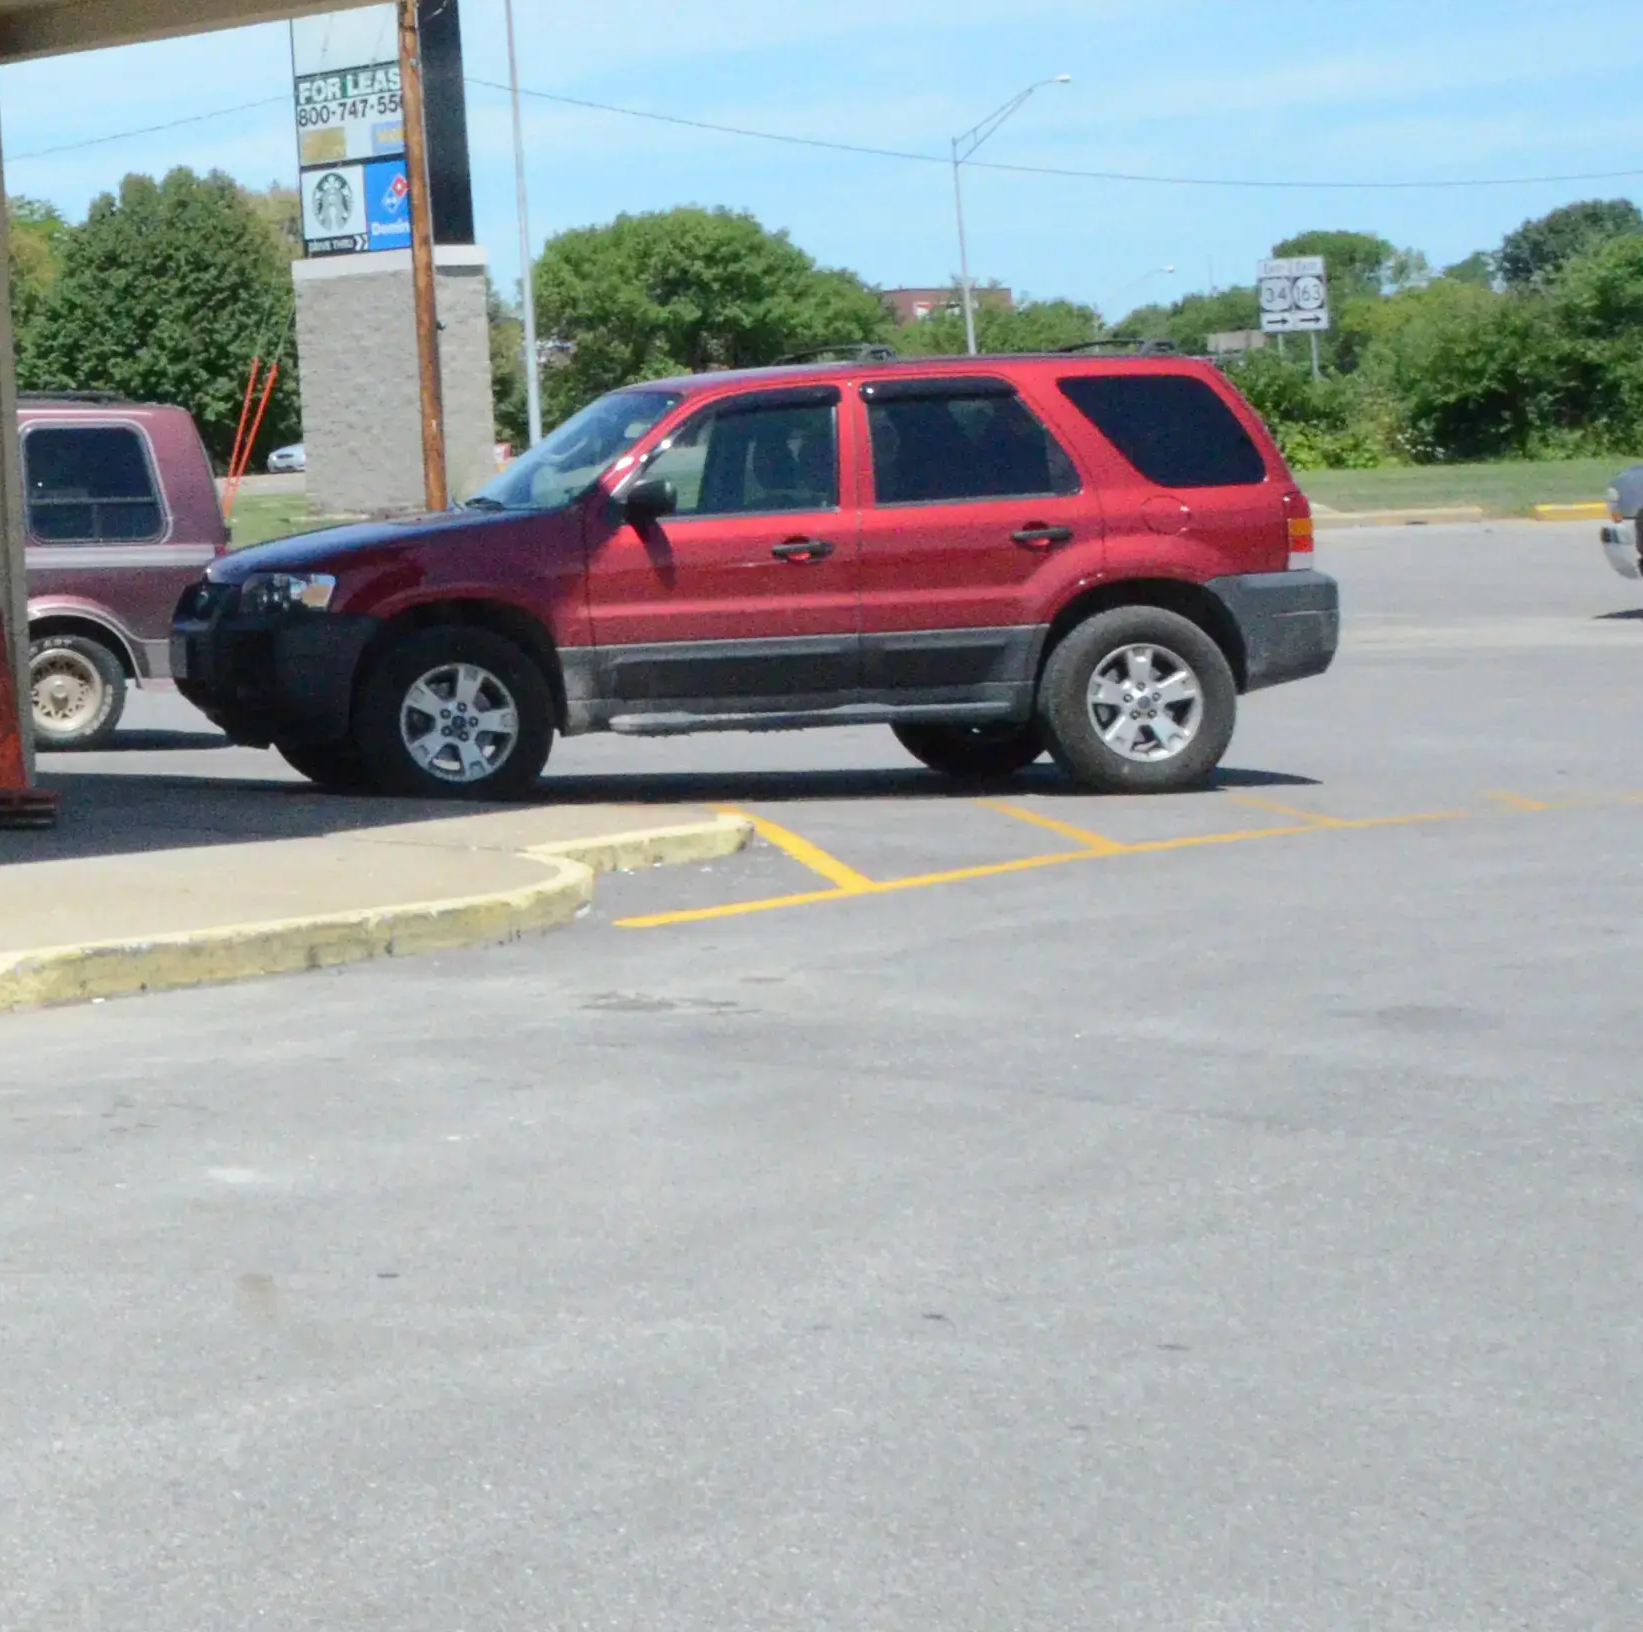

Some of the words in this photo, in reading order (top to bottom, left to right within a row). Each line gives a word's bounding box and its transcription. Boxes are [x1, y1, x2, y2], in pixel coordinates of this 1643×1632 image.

[298, 77, 342, 106] FOR
[346, 67, 401, 97] LEAS
[298, 94, 402, 127] 800-747-55
[1265, 285, 1287, 303] 34
[1296, 283, 1321, 302] 163
